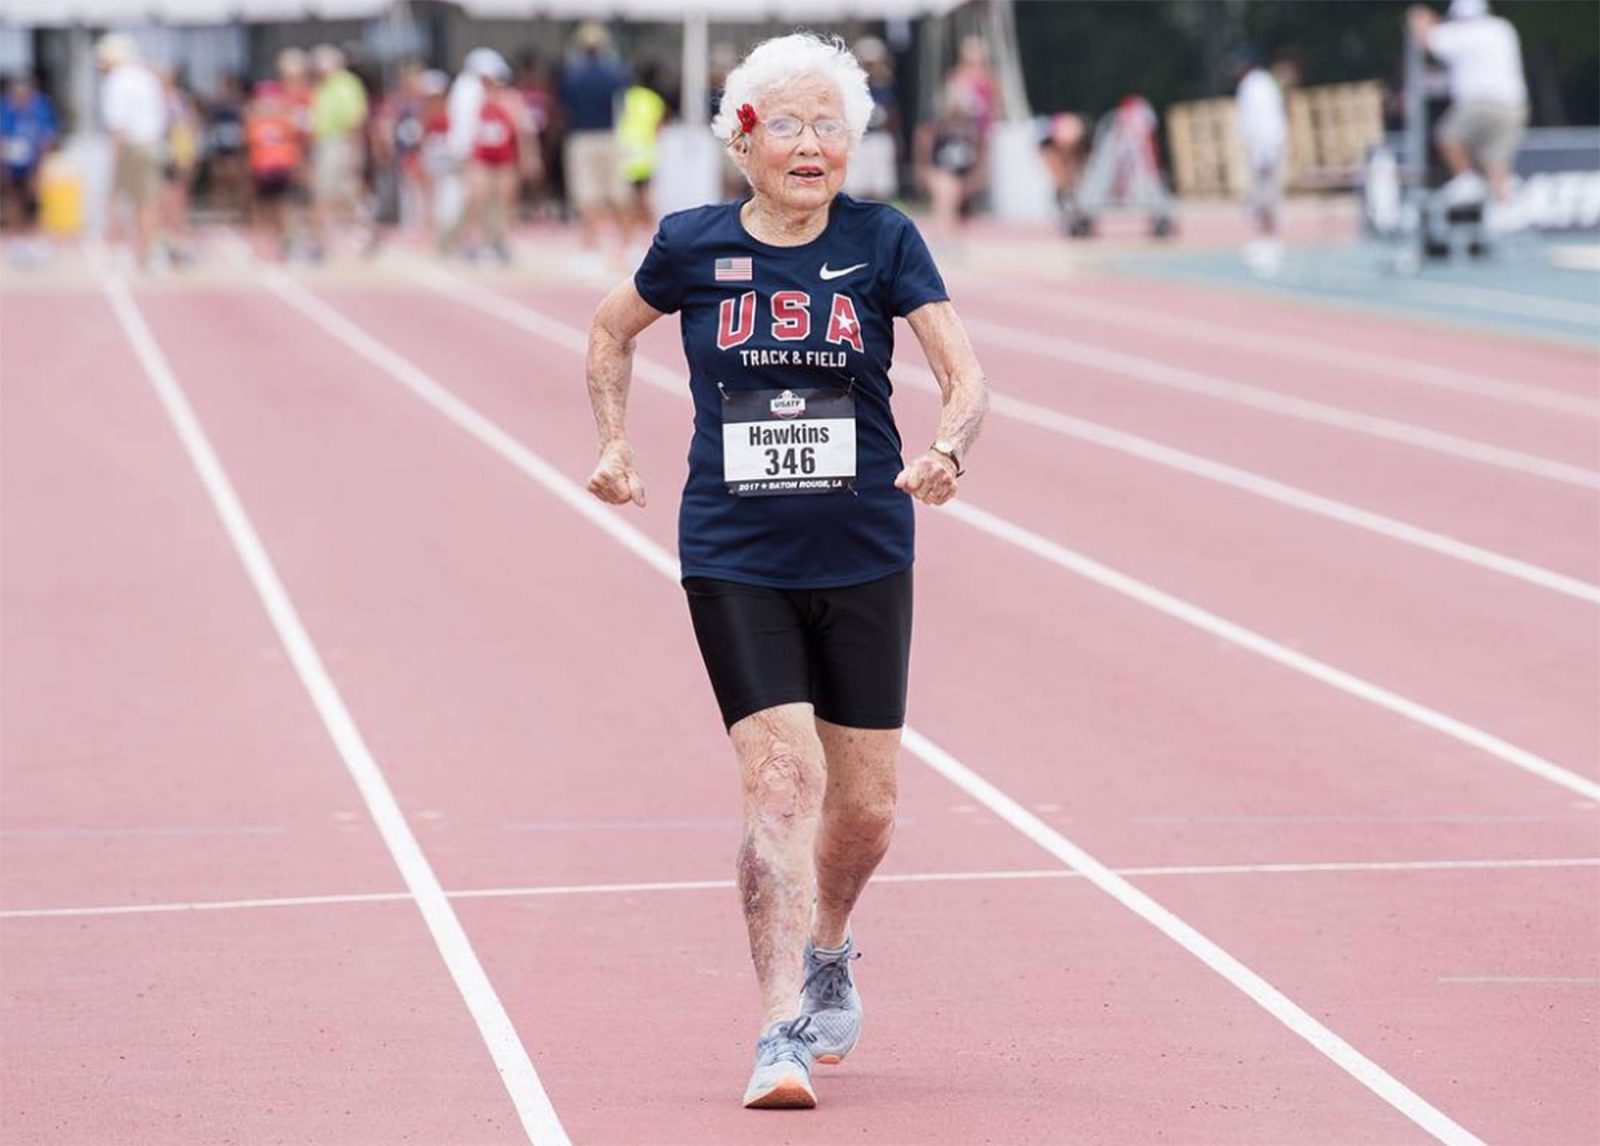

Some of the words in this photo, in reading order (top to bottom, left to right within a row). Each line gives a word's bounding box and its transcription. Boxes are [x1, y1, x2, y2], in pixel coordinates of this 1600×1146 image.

[717, 290, 864, 353] USA
[740, 350, 789, 366] TRACK
[792, 351, 802, 366] &
[806, 351, 847, 367] FIELD
[749, 423, 830, 446] Hawkins
[764, 446, 816, 476] 346
[738, 483, 759, 492] 2017
[768, 481, 798, 490] BATON
[832, 479, 842, 488] LA
